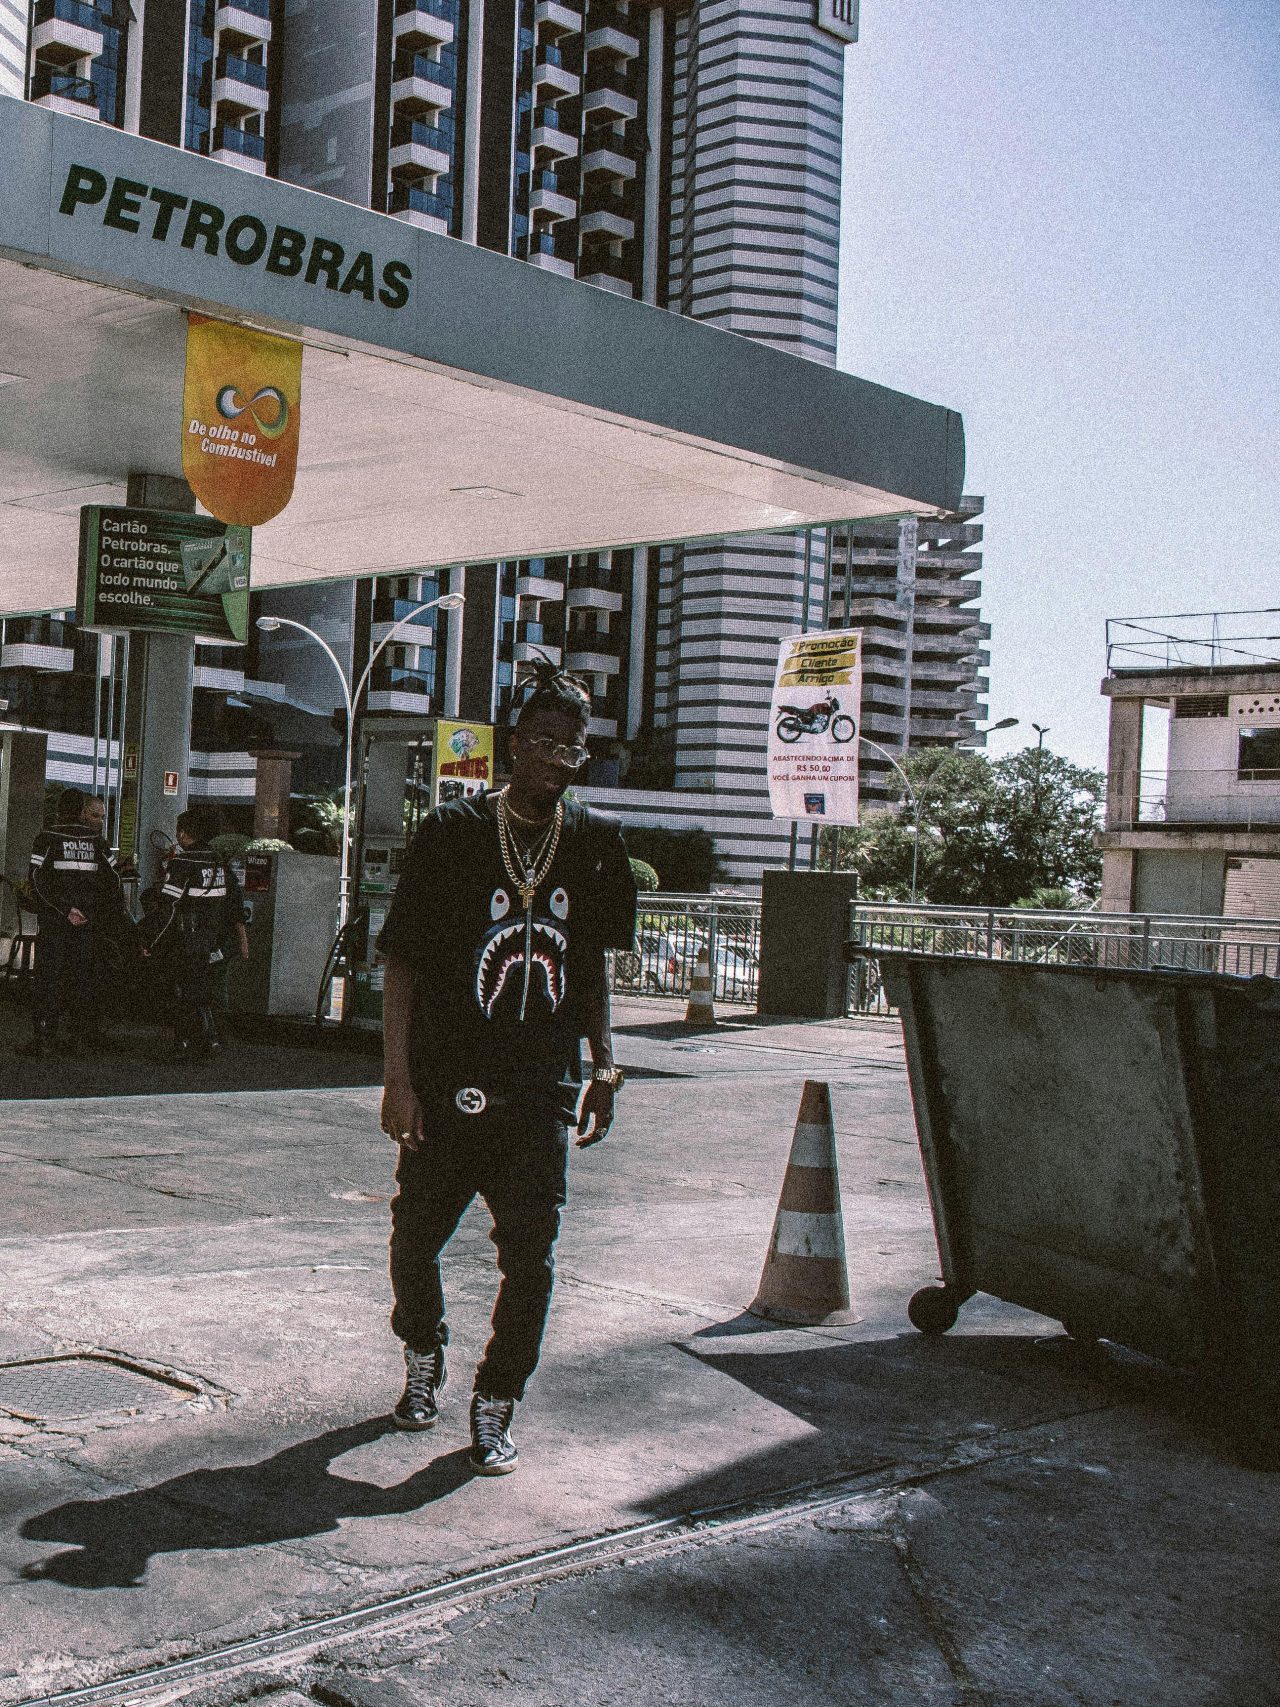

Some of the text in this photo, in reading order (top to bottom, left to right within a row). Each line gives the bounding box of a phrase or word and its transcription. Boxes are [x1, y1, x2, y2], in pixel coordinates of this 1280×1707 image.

[58, 163, 413, 309] PETROBRAS
[188, 419, 257, 446] De olho no
[200, 437, 278, 468] Combustível
[102, 518, 148, 534] Cartão
[101, 555, 179, 573] O cartão que
[99, 572, 178, 591] todo mundo
[98, 591, 155, 606] escolhe.
[797, 637, 854, 651] Promoção
[800, 657, 838, 668] Cliente
[797, 673, 835, 686] Amigo
[797, 764, 807, 772] R$
[772, 773, 790, 781] VOCÊ
[62, 840, 95, 851] POLÍCIA
[63, 850, 95, 860] MILITAR
